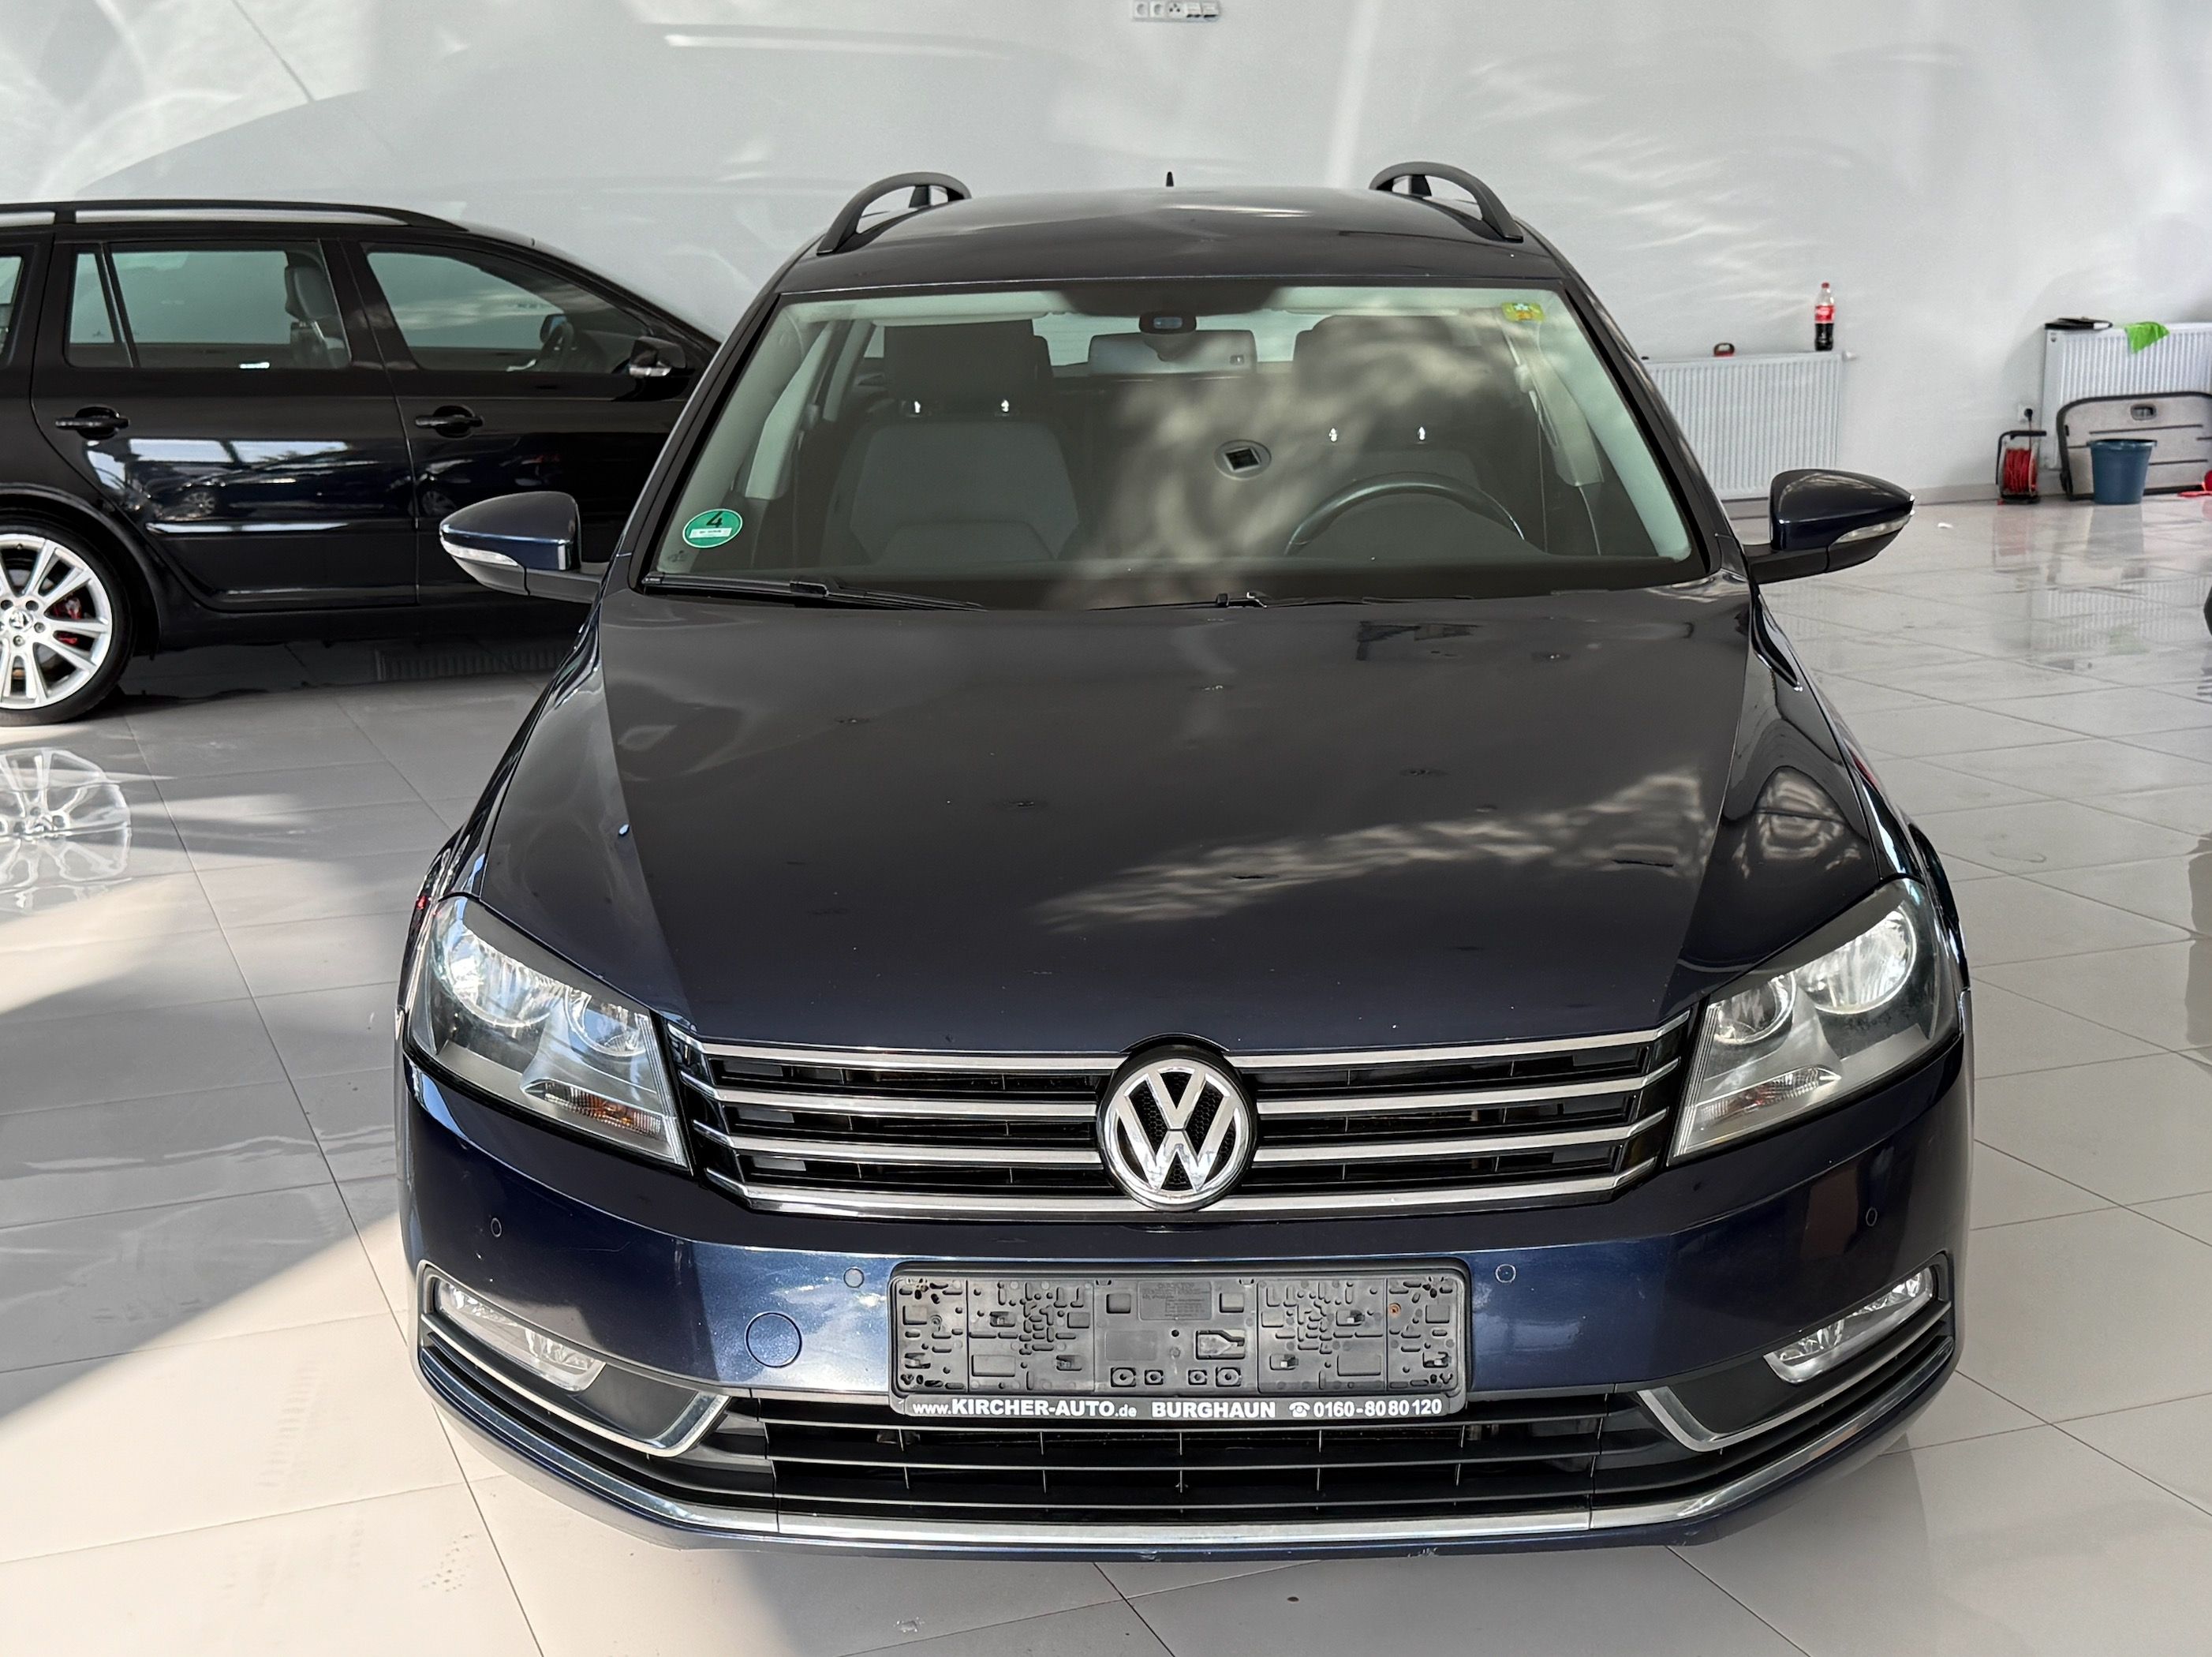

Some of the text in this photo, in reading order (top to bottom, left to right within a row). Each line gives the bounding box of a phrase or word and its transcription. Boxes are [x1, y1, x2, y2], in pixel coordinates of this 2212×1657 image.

[705, 511, 723, 529] 4
[1104, 1058, 1250, 1204] VW
[912, 1398, 1138, 1418] www.KIRCHER-AUTO.de
[1152, 1401, 1276, 1418] BURGHAUN
